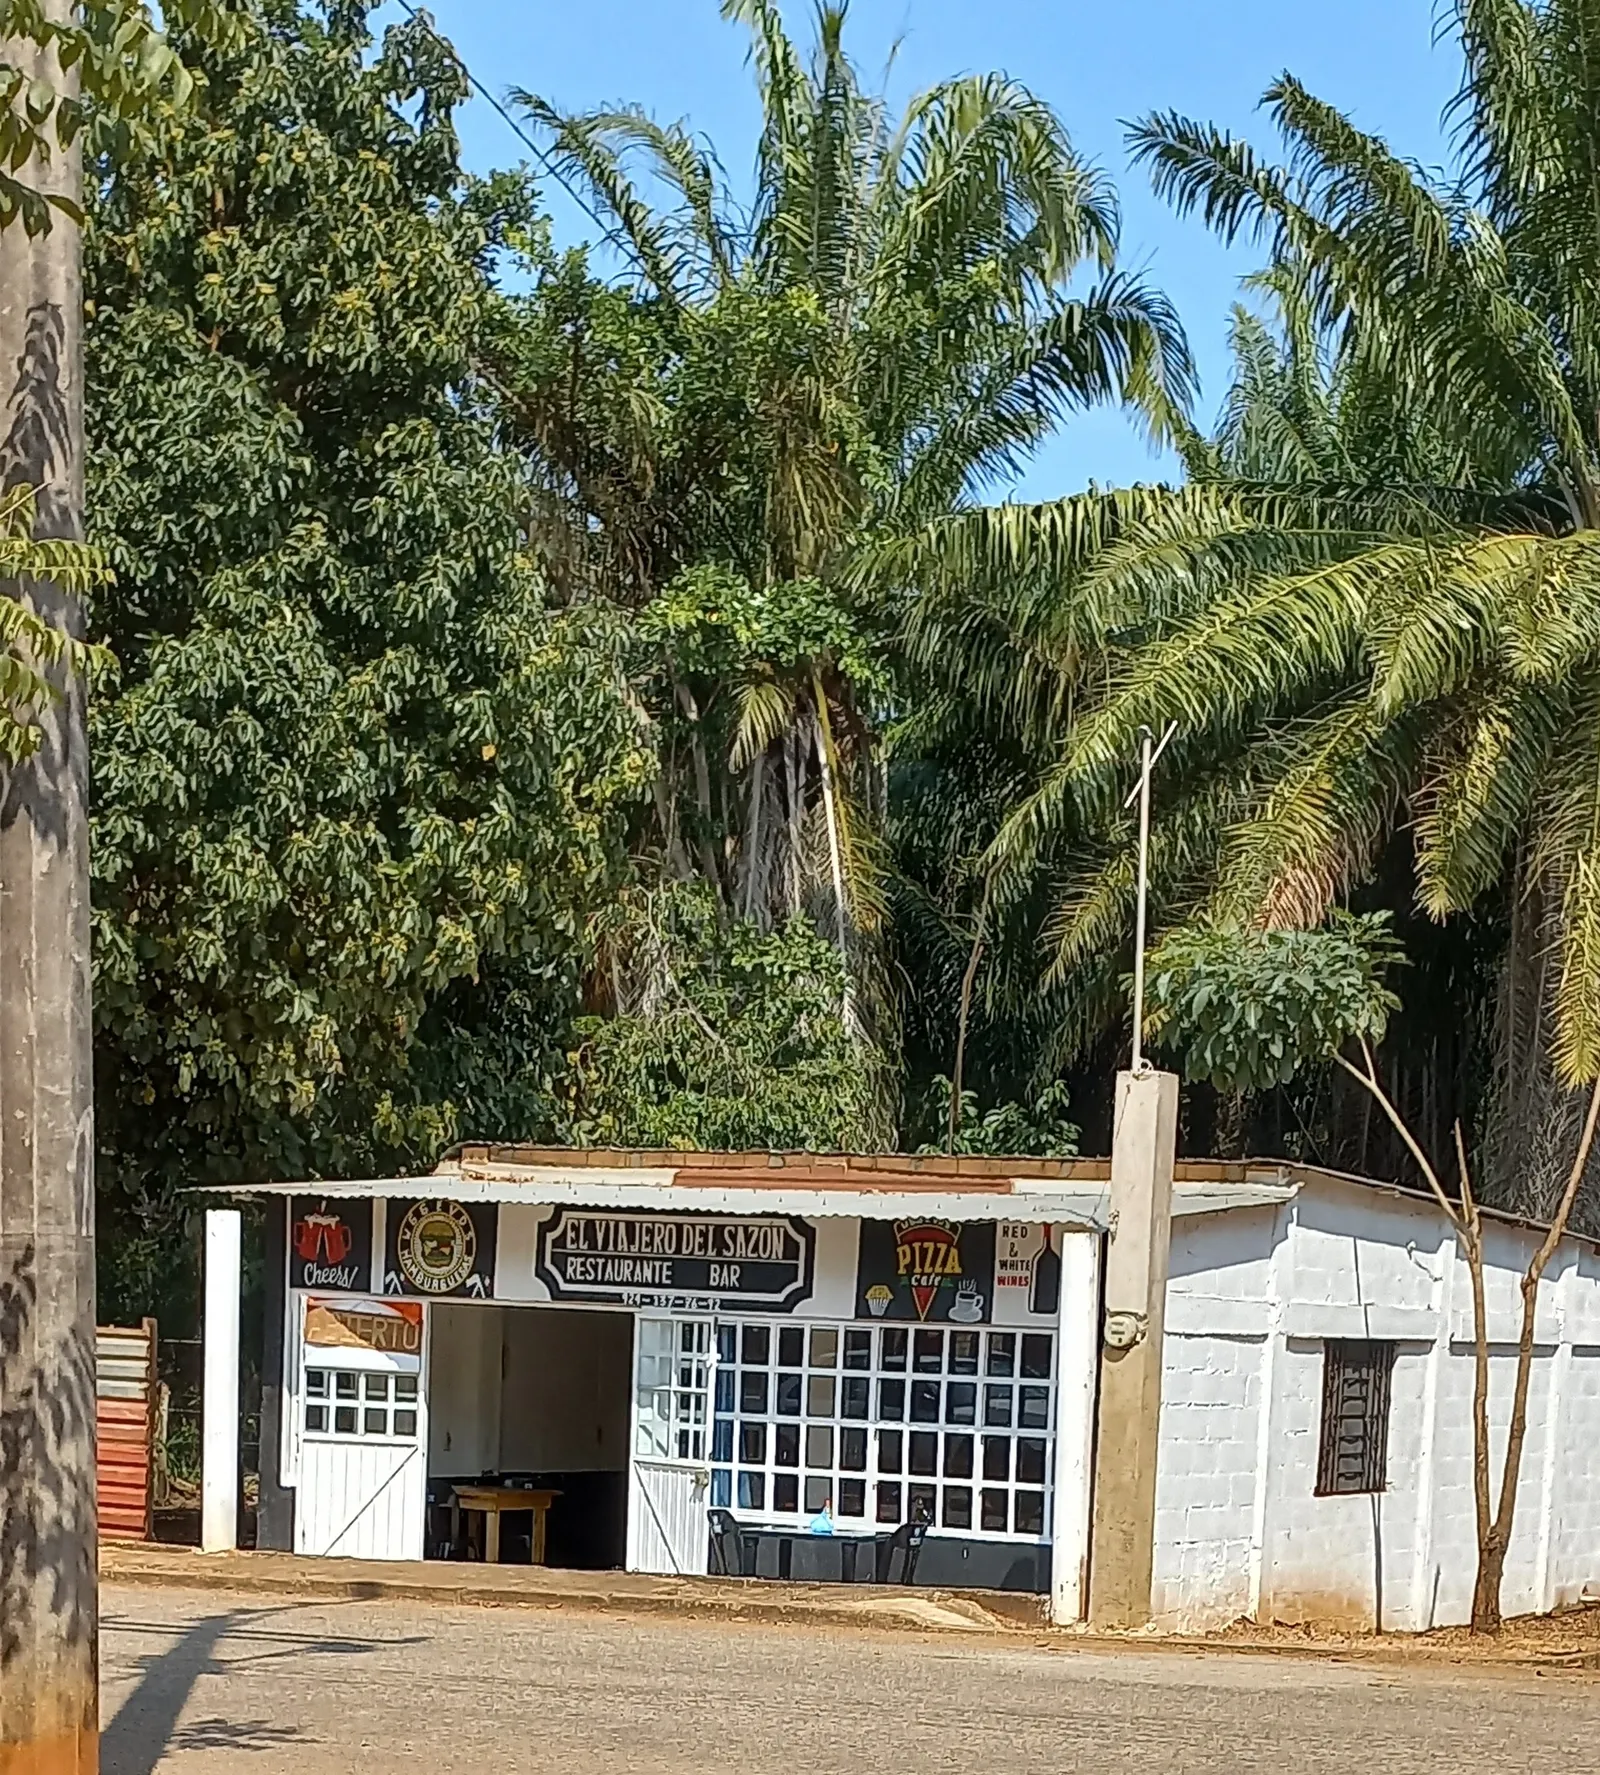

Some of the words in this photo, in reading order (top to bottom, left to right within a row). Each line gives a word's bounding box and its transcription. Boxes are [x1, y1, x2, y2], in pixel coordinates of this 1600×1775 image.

[566, 1219, 589, 1250] EL
[594, 1220, 676, 1255] VIAJERO
[681, 1224, 717, 1257] DEL
[1002, 1225, 1028, 1239] RED
[896, 1241, 962, 1275] PIZZA
[1008, 1242, 1019, 1258] &
[566, 1257, 673, 1285] RESTAURANTE
[709, 1263, 741, 1288] BAR
[998, 1259, 1031, 1271] WHITE
[997, 1275, 1029, 1287] WINES
